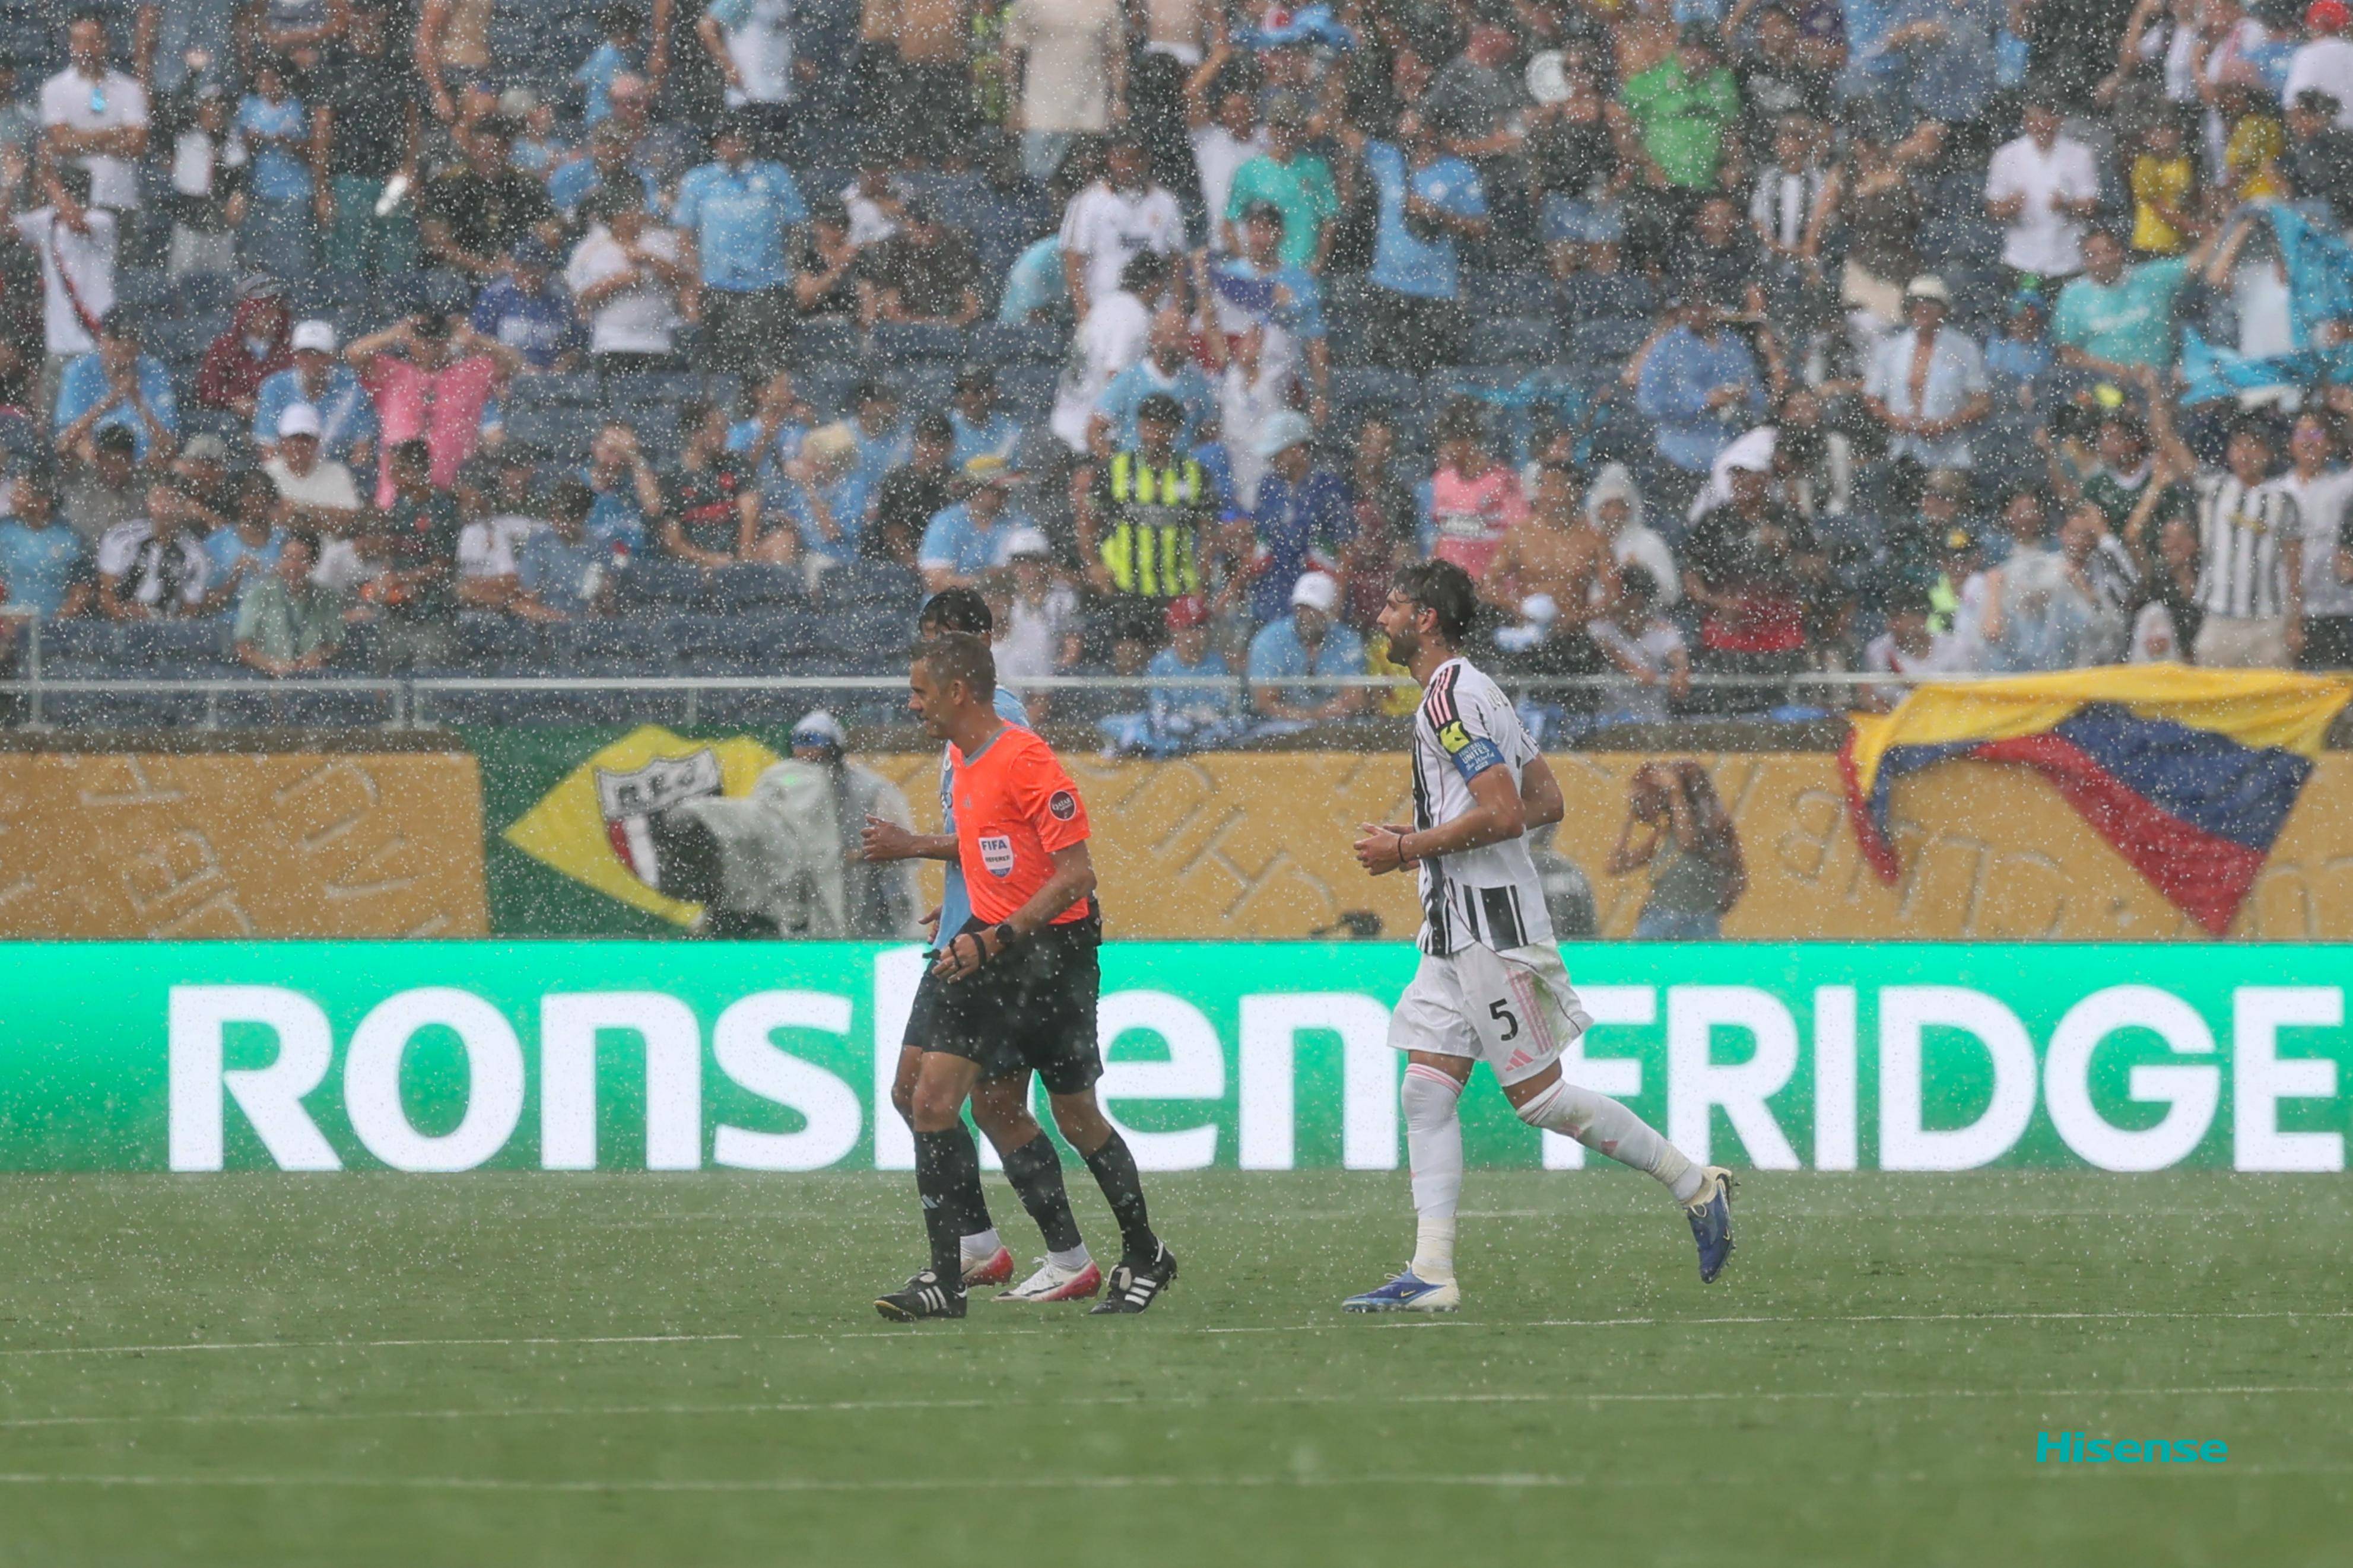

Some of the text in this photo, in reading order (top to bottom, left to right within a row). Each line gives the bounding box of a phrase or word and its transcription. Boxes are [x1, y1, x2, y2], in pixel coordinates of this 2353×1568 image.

[1462, 746, 1490, 764] UNITES
[981, 839, 1008, 851] FIFA
[1488, 998, 1519, 1041] 5
[1543, 985, 2344, 1173] FRIDGE
